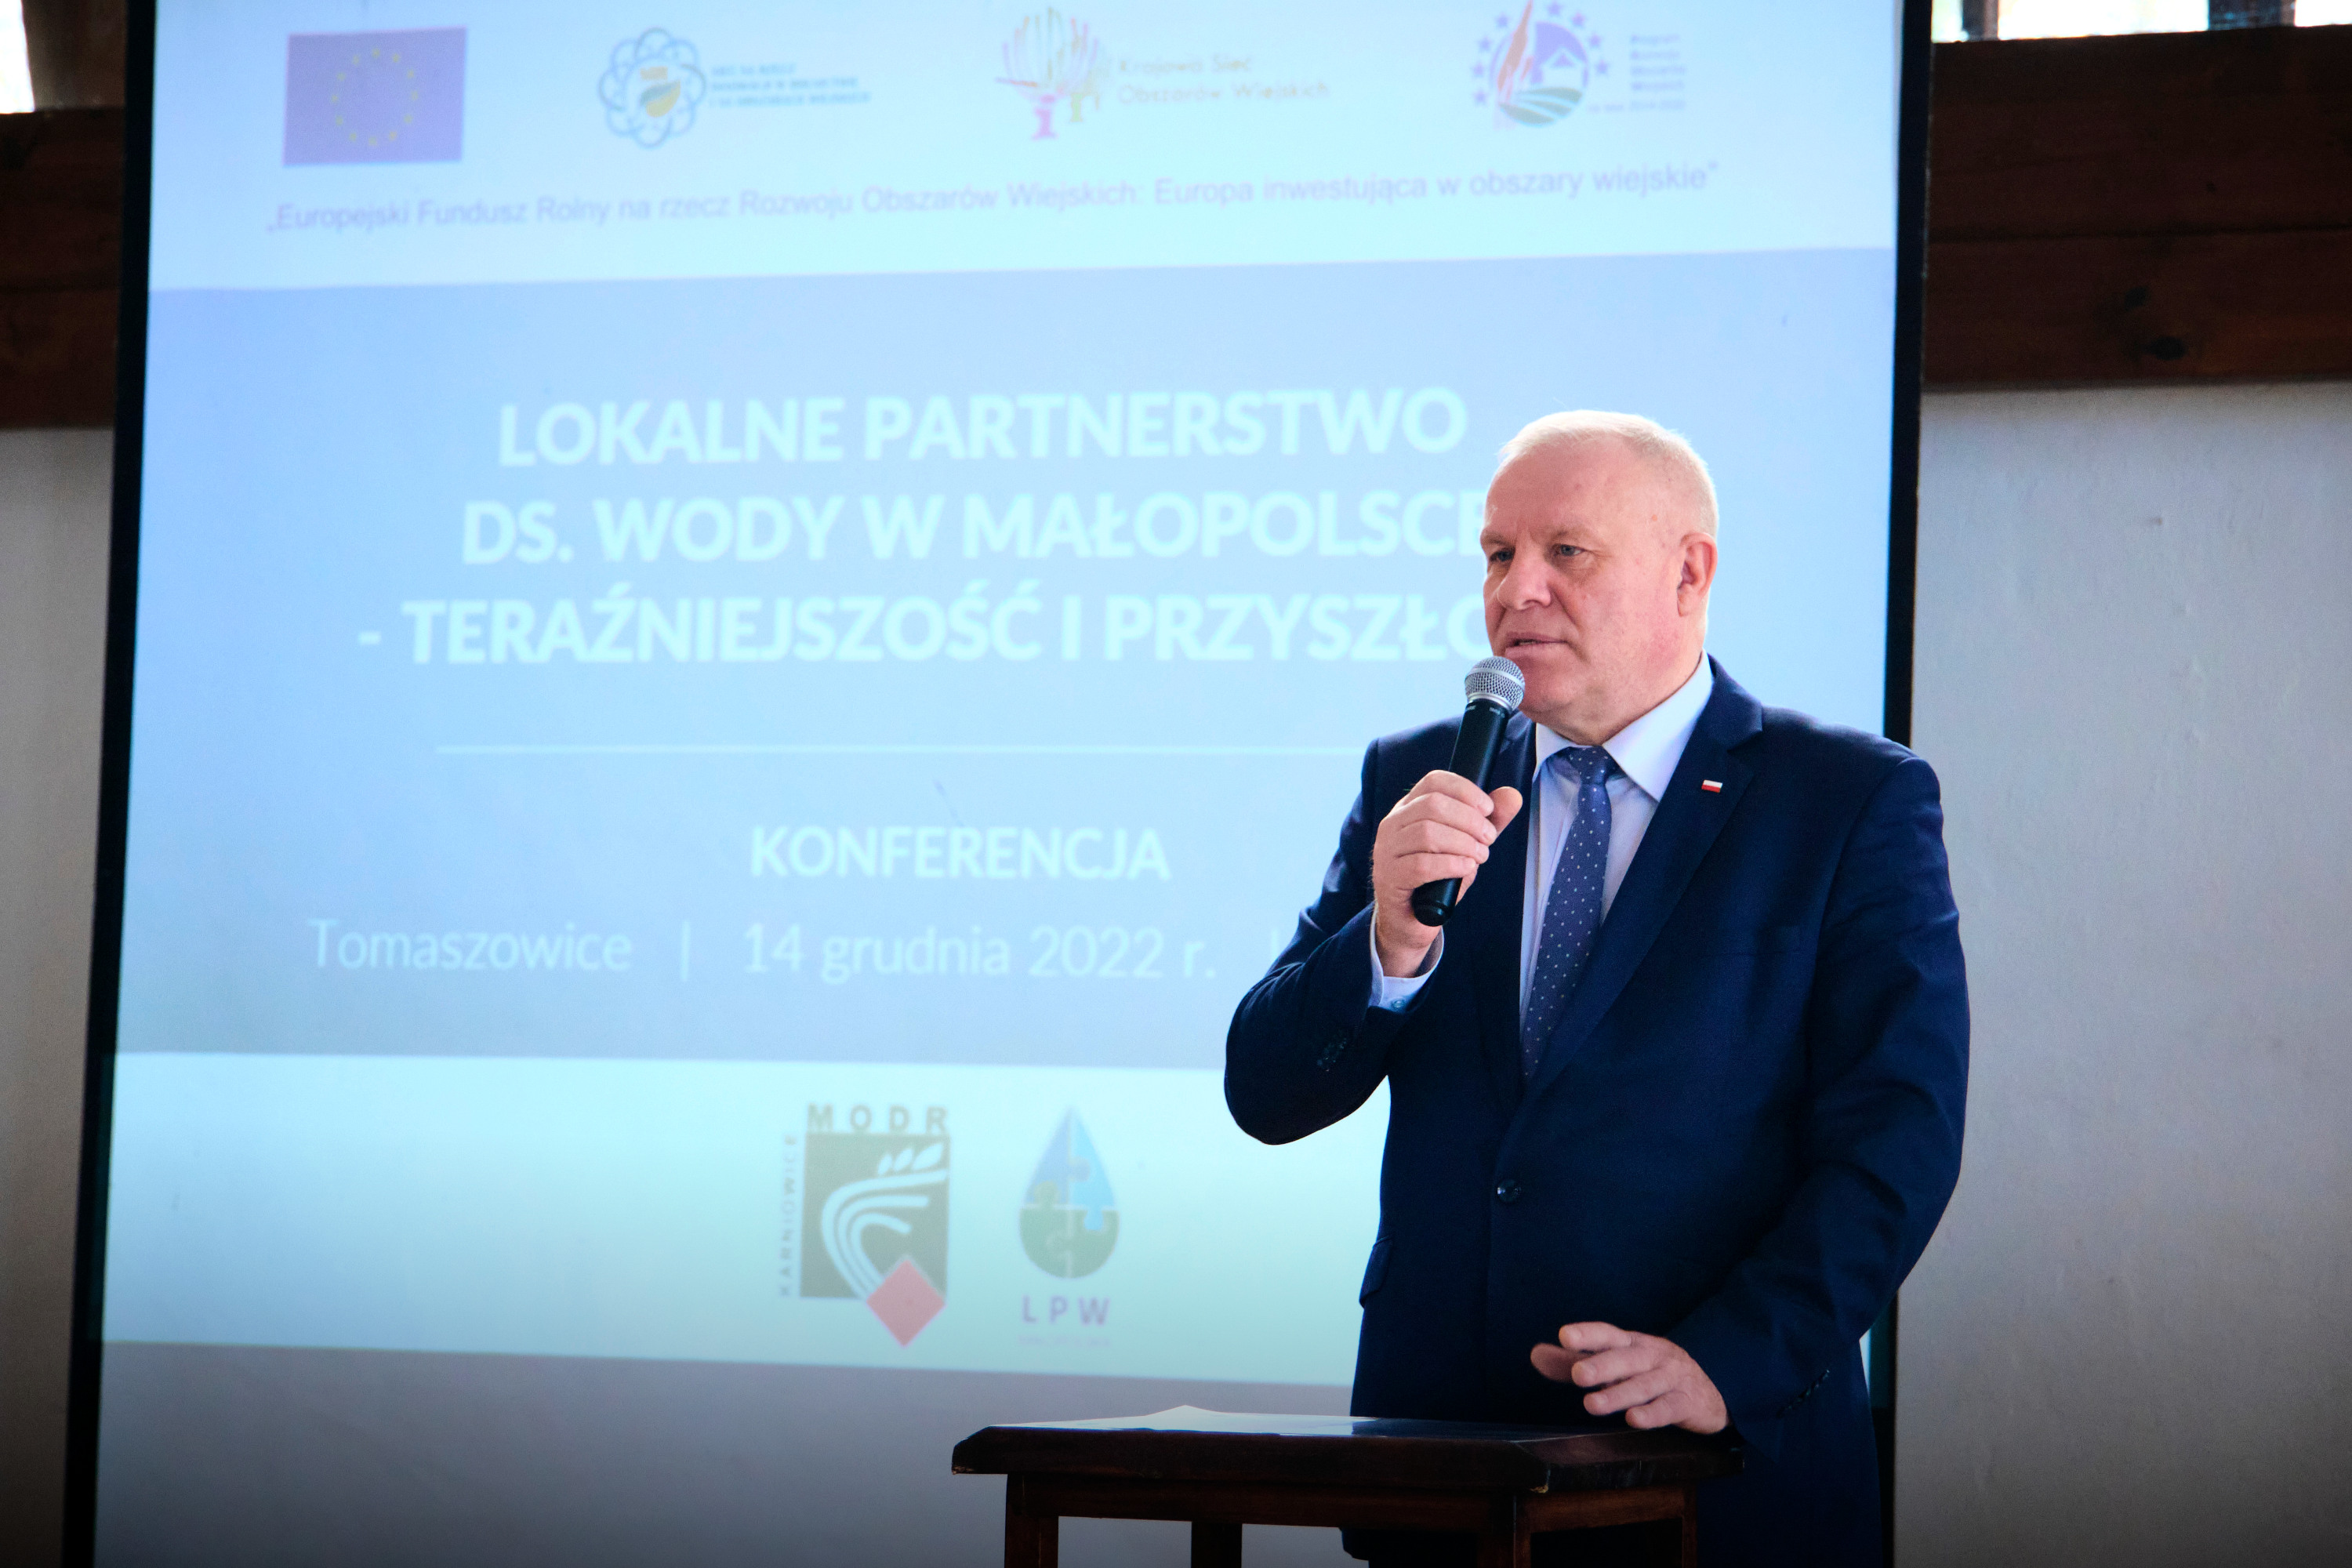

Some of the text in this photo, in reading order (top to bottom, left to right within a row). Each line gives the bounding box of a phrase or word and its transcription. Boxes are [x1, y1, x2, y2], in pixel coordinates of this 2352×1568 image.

[418, 197, 528, 227] Fundusz
[536, 195, 610, 227] Rolny
[619, 200, 651, 221] na
[659, 196, 731, 219] rzecz
[740, 188, 852, 221] Rozwoju
[861, 182, 1000, 213] Obszarów
[1154, 176, 1254, 209] Europa
[1263, 171, 1428, 205] inwestująca
[1437, 175, 1461, 196] w
[1469, 169, 1584, 201] obszary
[499, 387, 1468, 467] LOKALNE PARTNERSTWO
[463, 488, 1486, 564] DS. WODY W MAŁOPOLSCE
[401, 579, 1044, 665] TERAŹNIEJSZOŚĆ
[1061, 593, 1083, 662] I
[1105, 593, 1493, 662] PRZYSZŁO
[750, 825, 1171, 880] KONFERENCJA
[307, 918, 633, 971] Tomaszowice
[743, 924, 805, 975] 14
[821, 925, 1011, 985] grudnia
[1029, 925, 1166, 979] 2022
[1183, 938, 1217, 978] r.
[807, 1104, 948, 1134] MODR
[779, 1134, 798, 1298] KARNIOWICE
